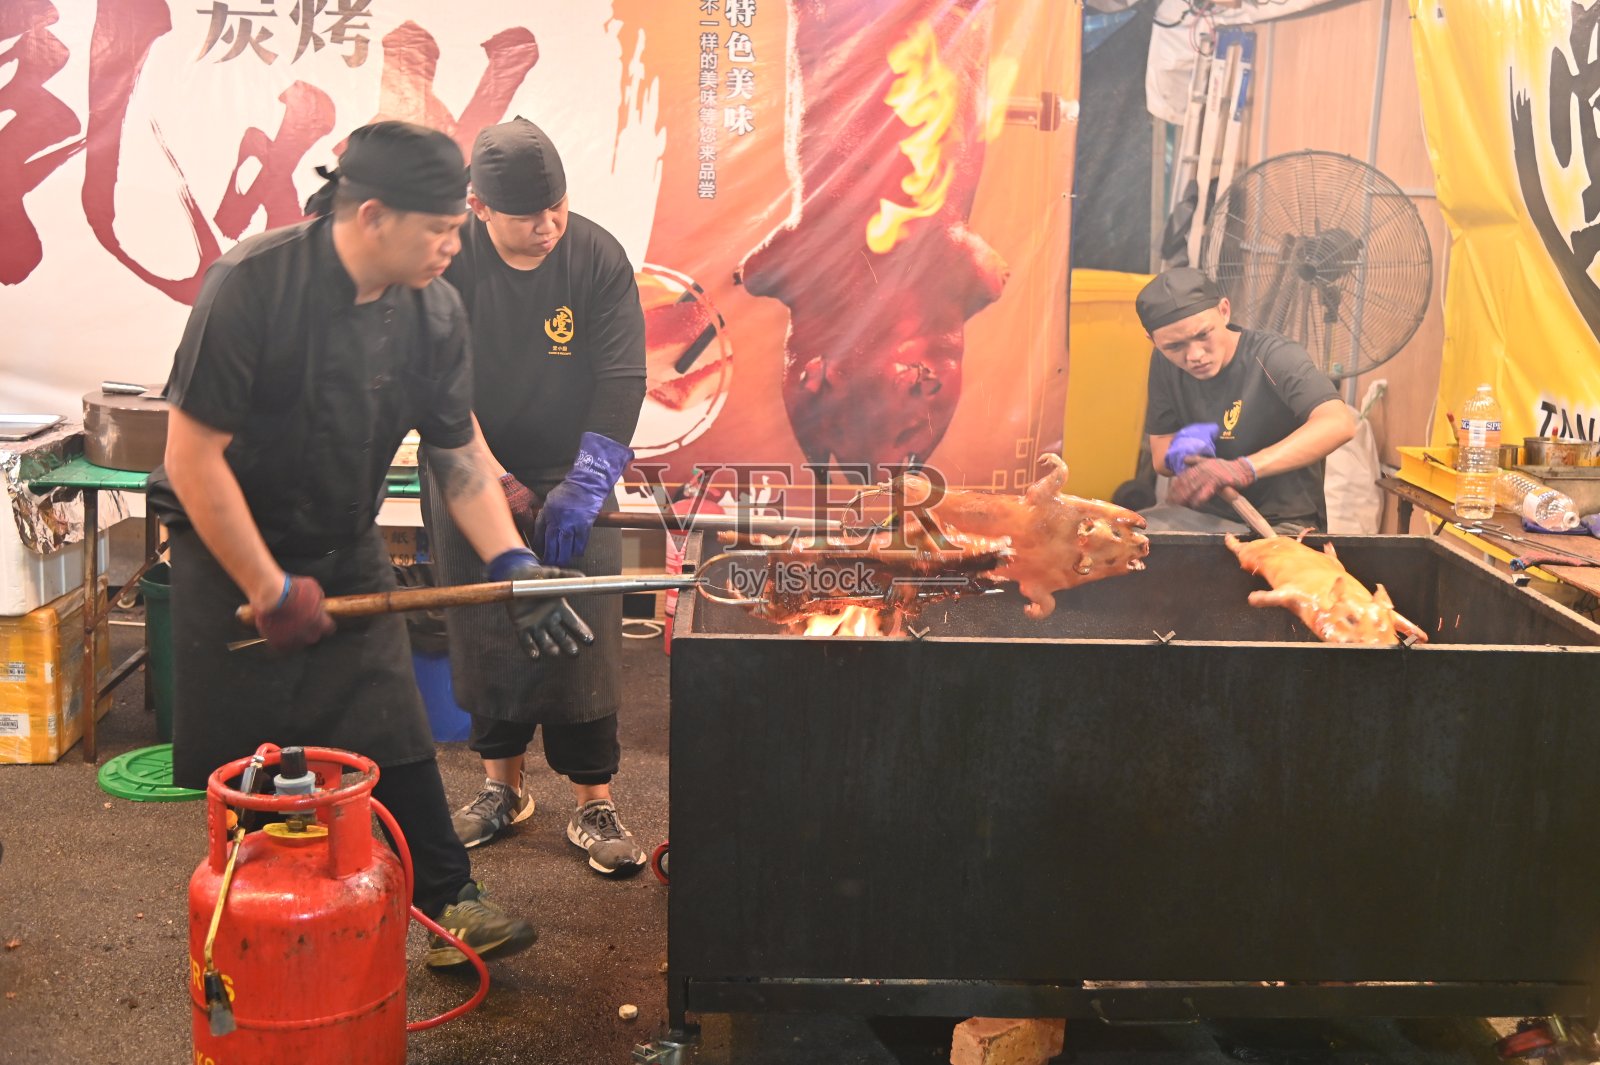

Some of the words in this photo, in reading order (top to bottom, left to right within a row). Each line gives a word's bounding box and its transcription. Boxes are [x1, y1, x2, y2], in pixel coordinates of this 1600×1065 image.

[194, 0, 373, 68] 炭烤
[724, 0, 757, 136] 特色美味
[698, 0, 720, 199] 不一样的美味等您来品尝
[1540, 401, 1600, 442] TAN
